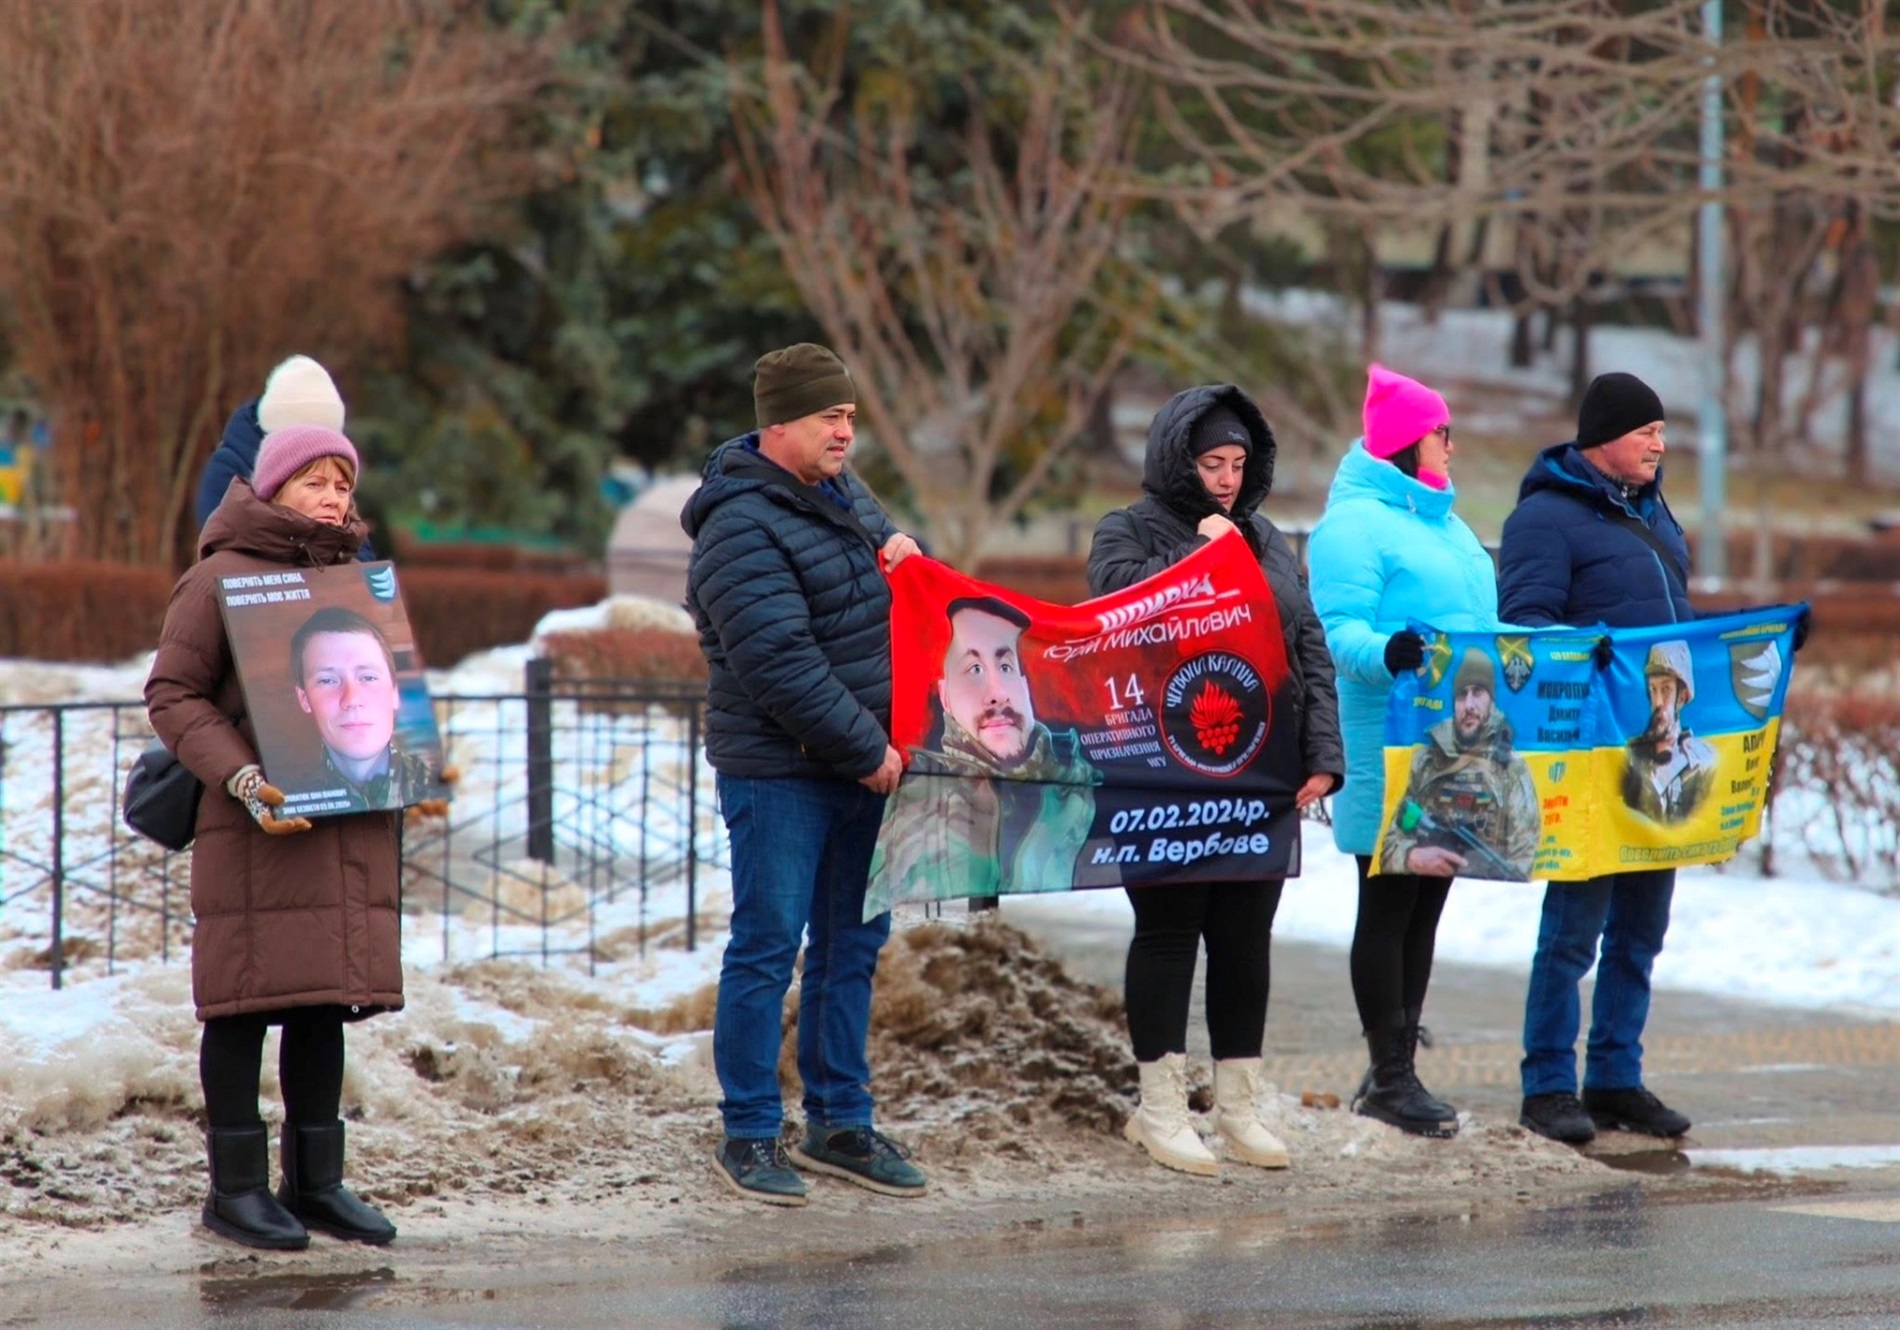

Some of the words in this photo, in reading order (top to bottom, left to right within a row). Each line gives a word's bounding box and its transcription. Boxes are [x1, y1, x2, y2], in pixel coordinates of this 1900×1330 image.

[1104, 673, 1144, 710] 14
[1104, 707, 1153, 726] БРИГАДА
[1080, 724, 1156, 746] ОПЕРАТИВНОГО
[1089, 740, 1161, 761] ПРИЗНАЧЕННЯ
[1110, 798, 1270, 834] 07.02.2024р.
[1091, 844, 1140, 864] н.п.
[1147, 832, 1270, 865] Вербове
